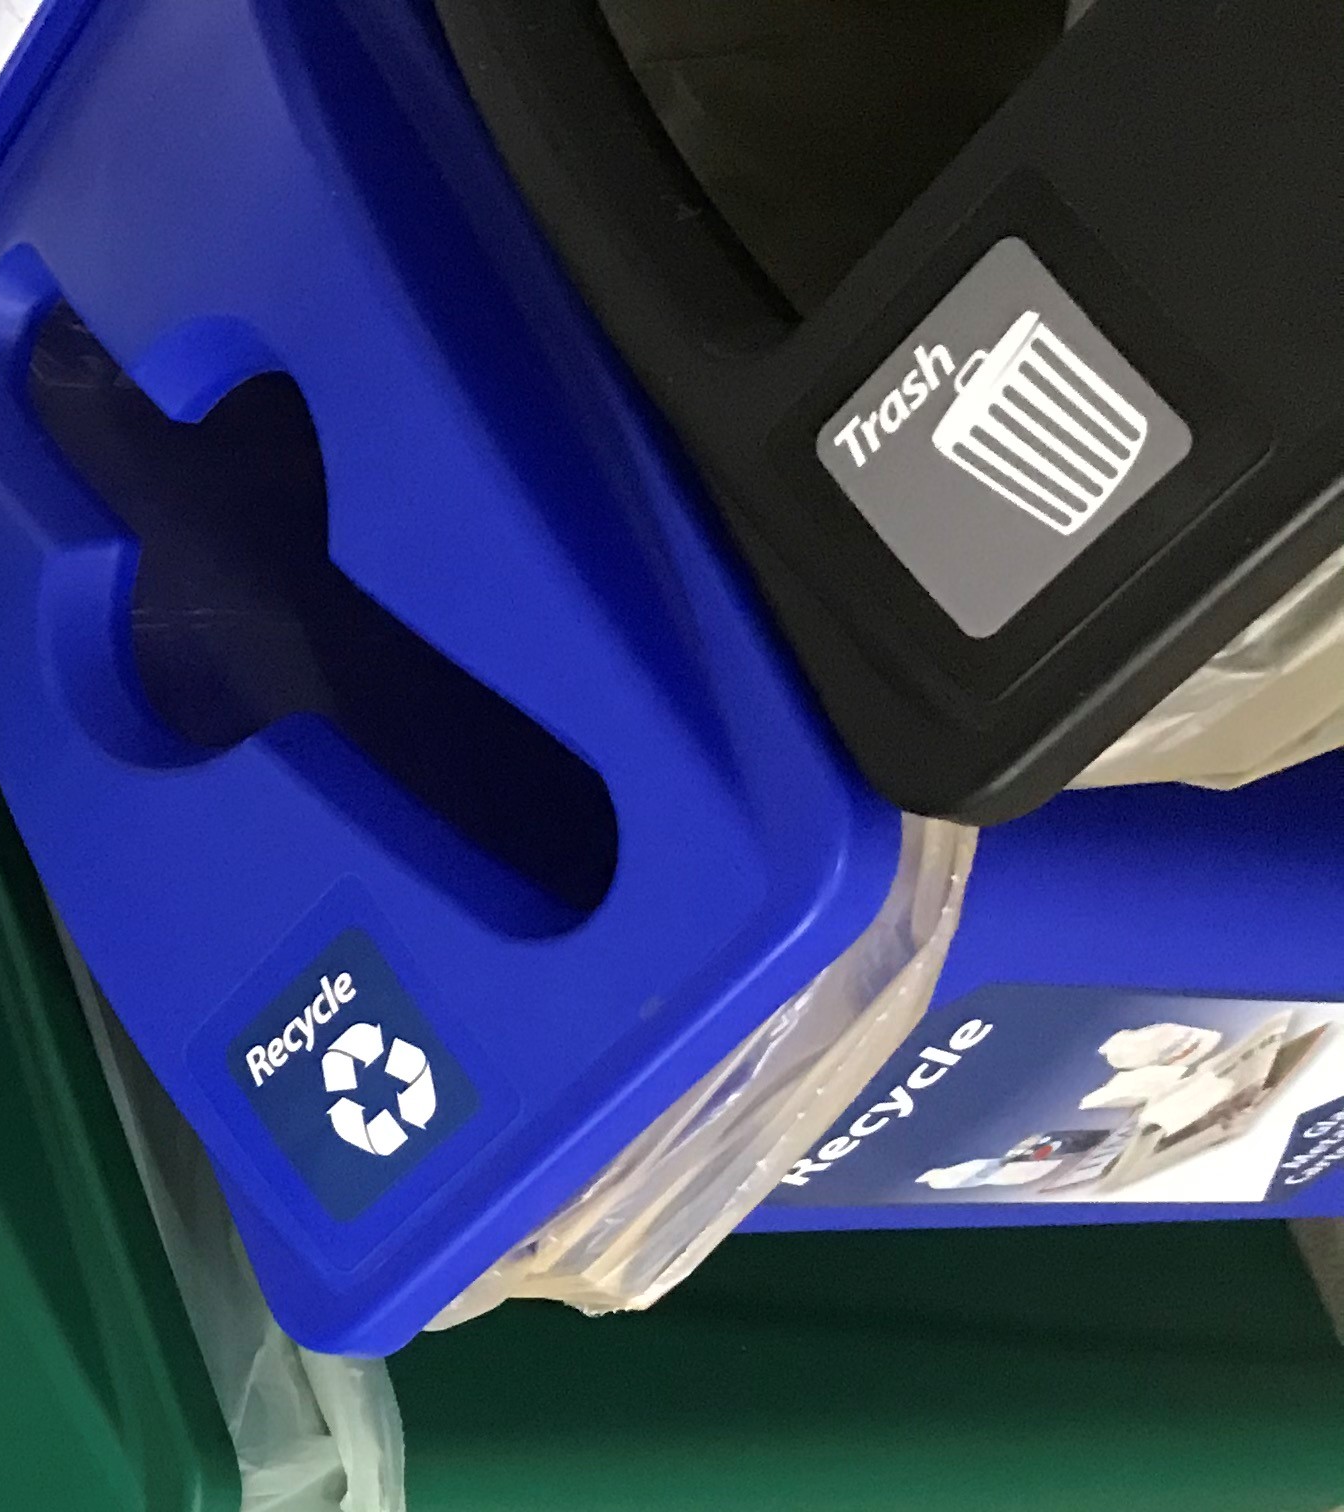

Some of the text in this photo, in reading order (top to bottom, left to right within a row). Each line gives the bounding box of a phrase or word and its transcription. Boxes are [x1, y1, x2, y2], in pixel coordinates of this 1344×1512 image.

[833, 343, 956, 467] Trash
[245, 972, 357, 1087] Recycle
[781, 1019, 993, 1186] Recycle
